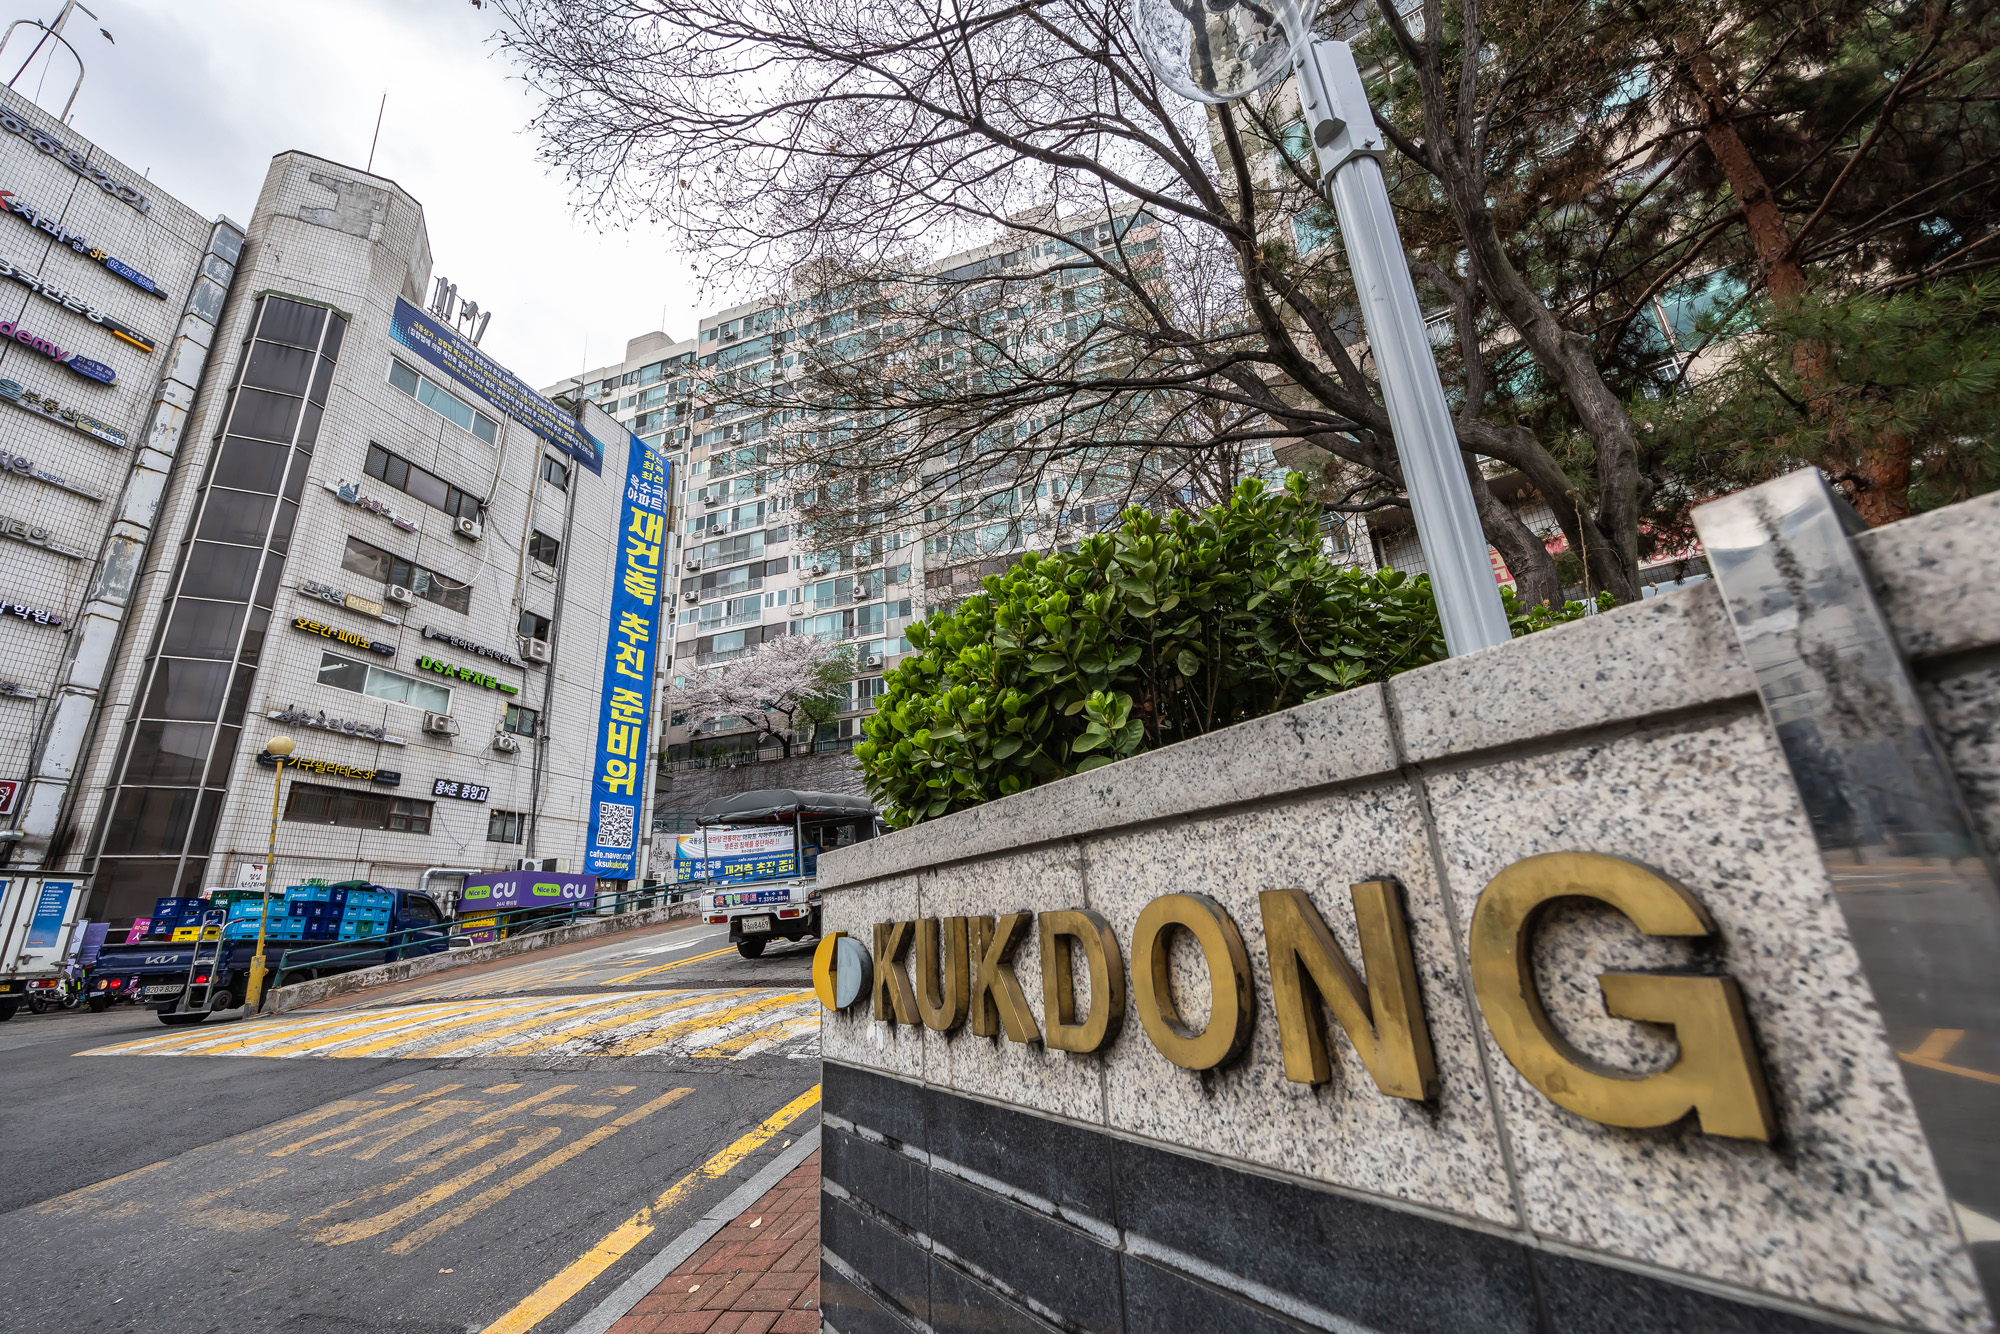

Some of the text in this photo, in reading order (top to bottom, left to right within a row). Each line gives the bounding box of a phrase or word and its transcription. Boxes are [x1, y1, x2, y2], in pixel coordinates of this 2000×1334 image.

[90, 247, 107, 261] 3F
[407, 326, 431, 346] (집합법에
[431, 343, 442, 355] 의한
[442, 350, 457, 365] 재건축
[413, 320, 434, 340] 극동상가
[437, 338, 453, 352] 집합법
[451, 338, 474, 359] 극동아파트
[474, 355, 493, 373] 종합상가
[80, 415, 126, 441] 2299-4880
[641, 471, 663, 485] 최선
[627, 487, 662, 511] 아파트
[349, 596, 379, 614] 머리방
[602, 505, 664, 796] 재건축 추진 준비위
[421, 655, 455, 677] DSA
[459, 667, 497, 690] 뮤지컬
[287, 756, 362, 779] 기구필라테스
[363, 769, 377, 780] 3F
[461, 784, 488, 801] 중앙고
[755, 840, 775, 848] 중단하라
[725, 862, 753, 877] 재건축
[757, 860, 776, 874] 추진
[468, 881, 517, 899] Nice to CU
[536, 883, 587, 899] Nice to CU
[145, 955, 178, 965] KIA
[873, 850, 1779, 1143] KUKDONG
